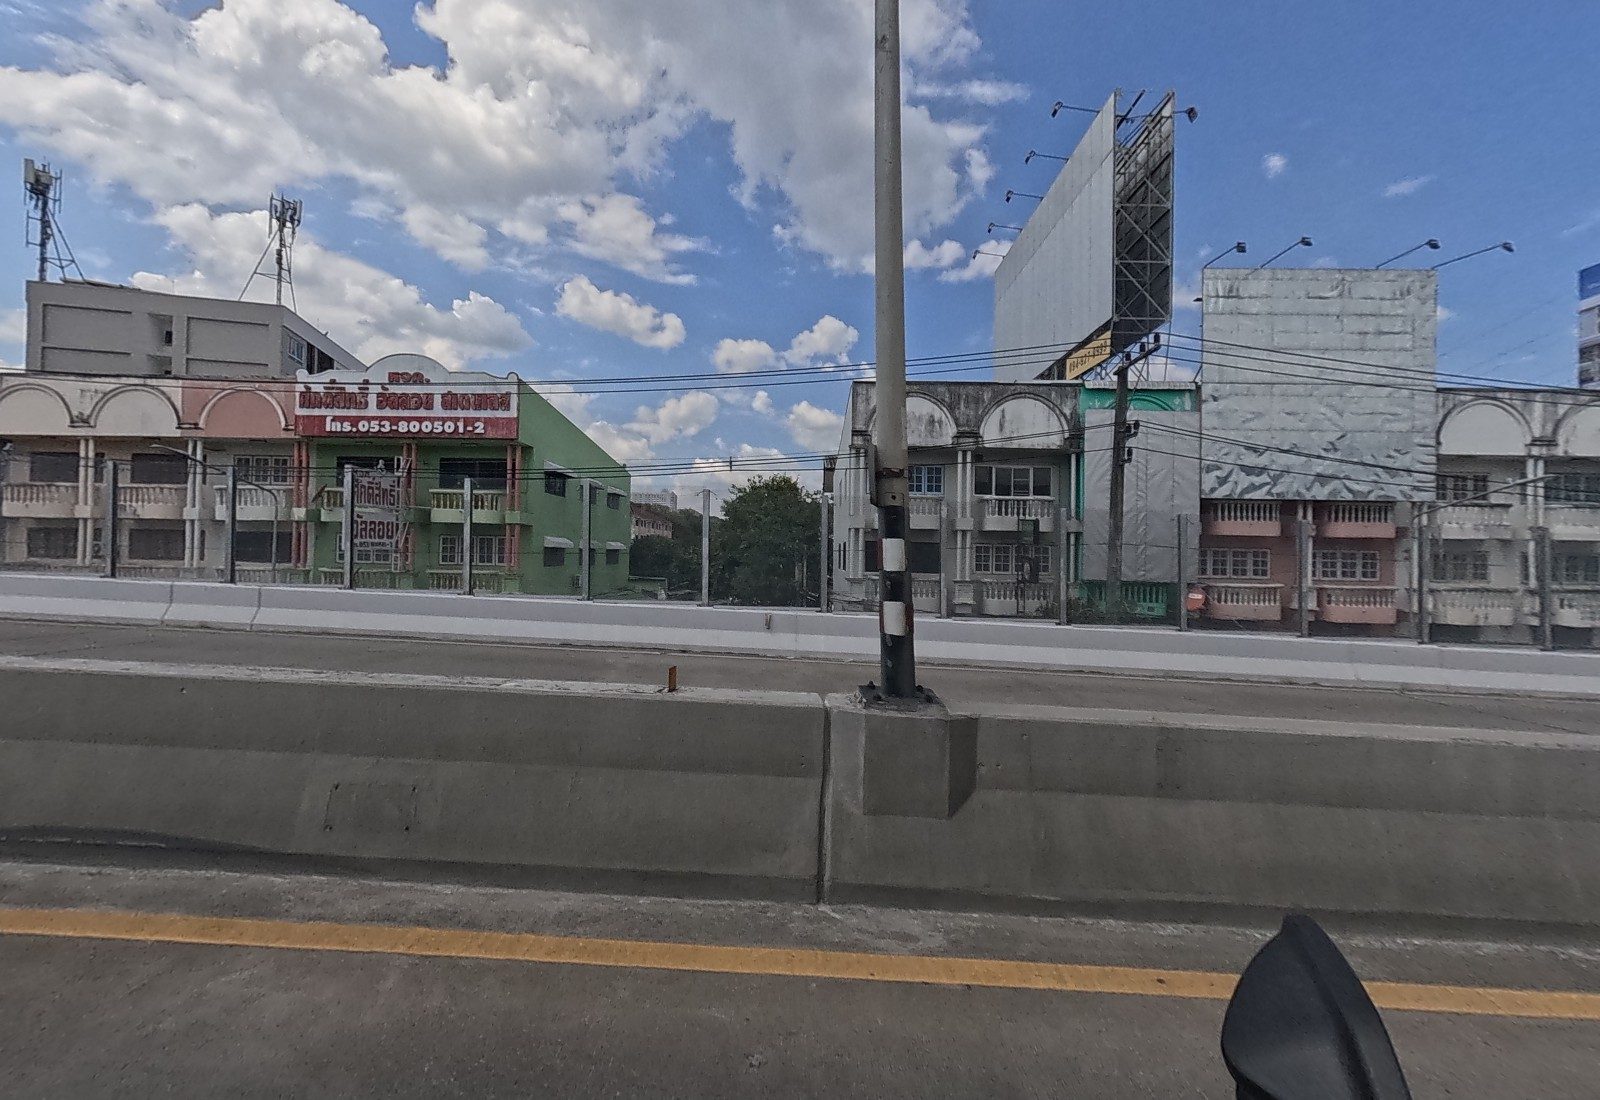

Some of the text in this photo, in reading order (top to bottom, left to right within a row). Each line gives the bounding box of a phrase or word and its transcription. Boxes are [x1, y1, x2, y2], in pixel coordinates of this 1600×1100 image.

[376, 384, 434, 411] อัลลอย
[325, 416, 485, 434] โทร.053-800501-2
